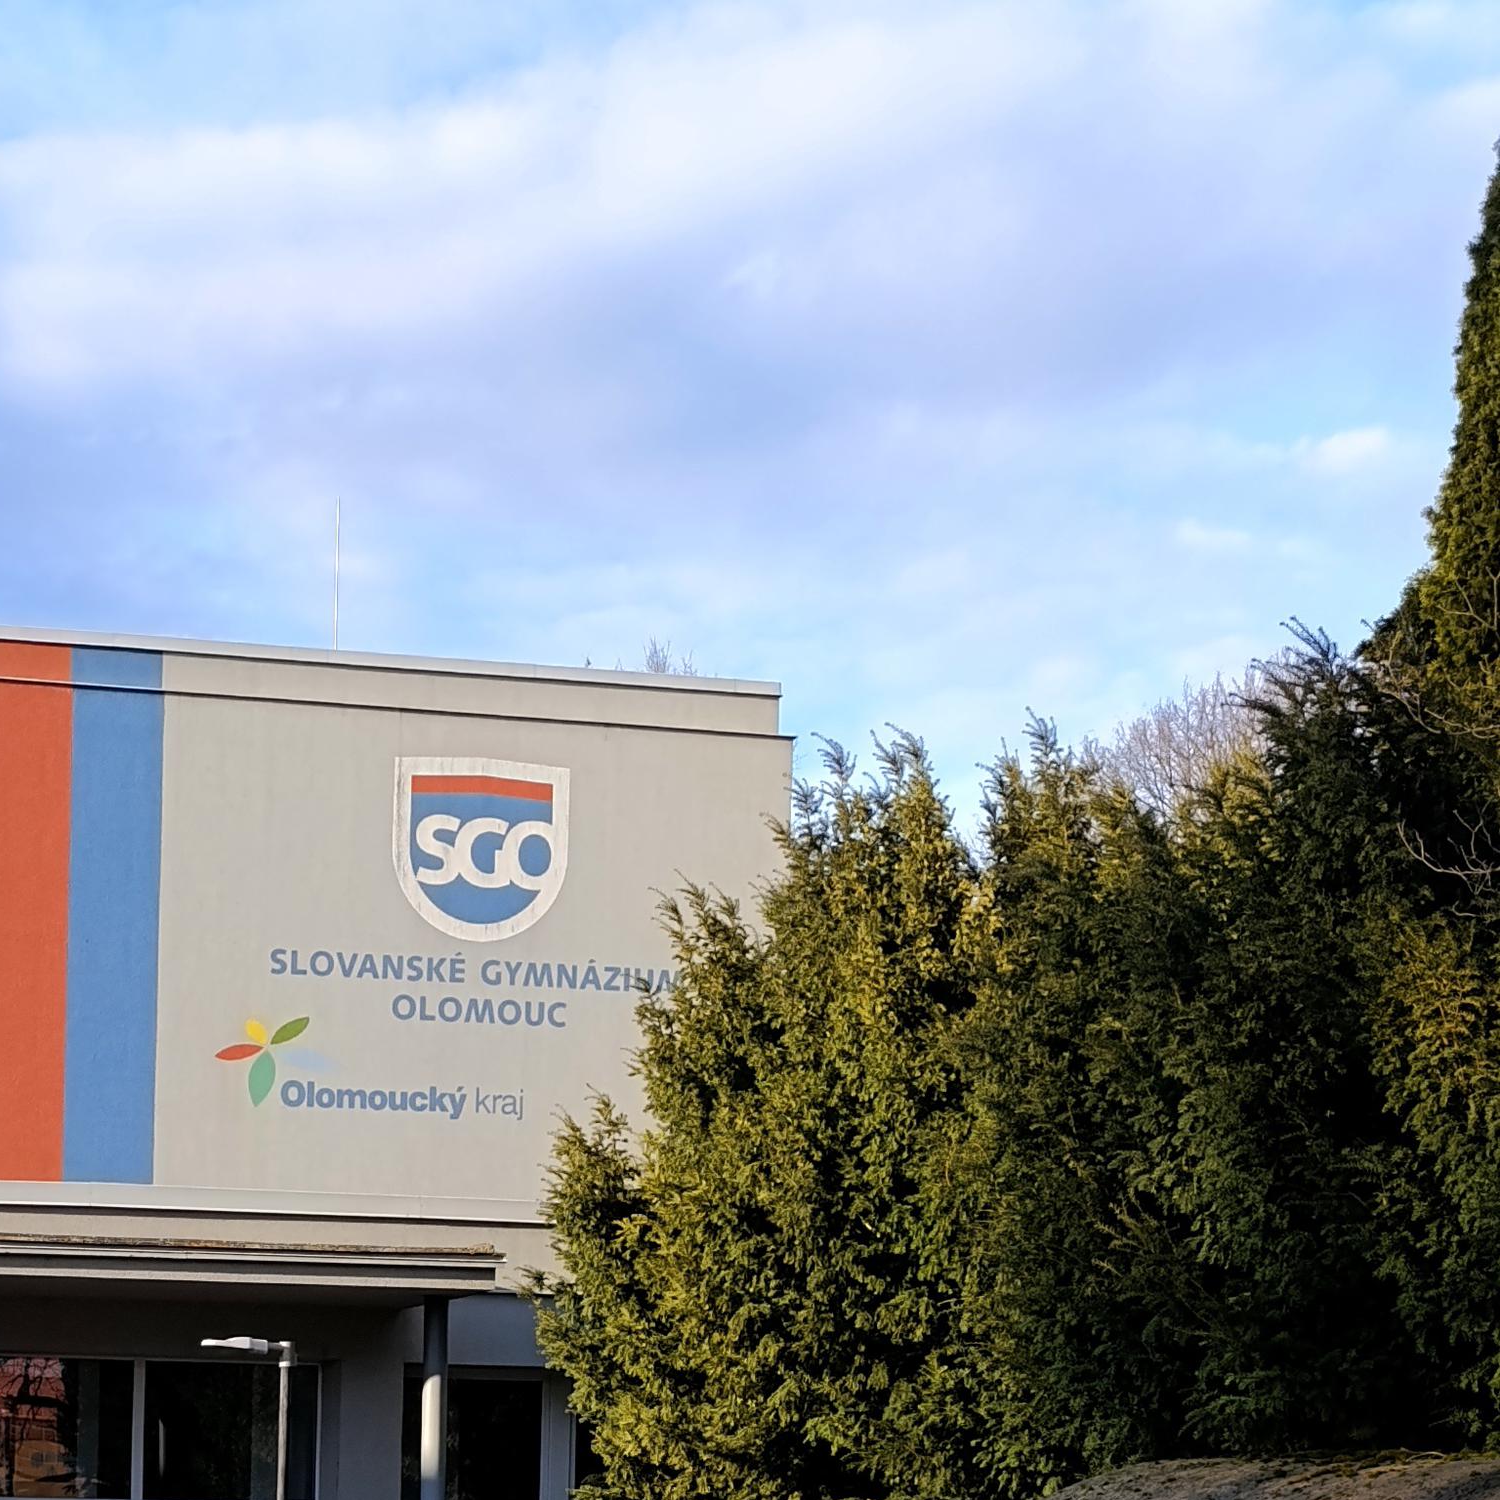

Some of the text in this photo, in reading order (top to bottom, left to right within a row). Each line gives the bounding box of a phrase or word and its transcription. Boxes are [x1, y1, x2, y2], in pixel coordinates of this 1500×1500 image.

[415, 814, 553, 891] SGO
[269, 948, 466, 983] SLOVANSKÉ
[392, 995, 567, 1028] OLOMOUC
[280, 1080, 525, 1120] Olomoucký kraj
